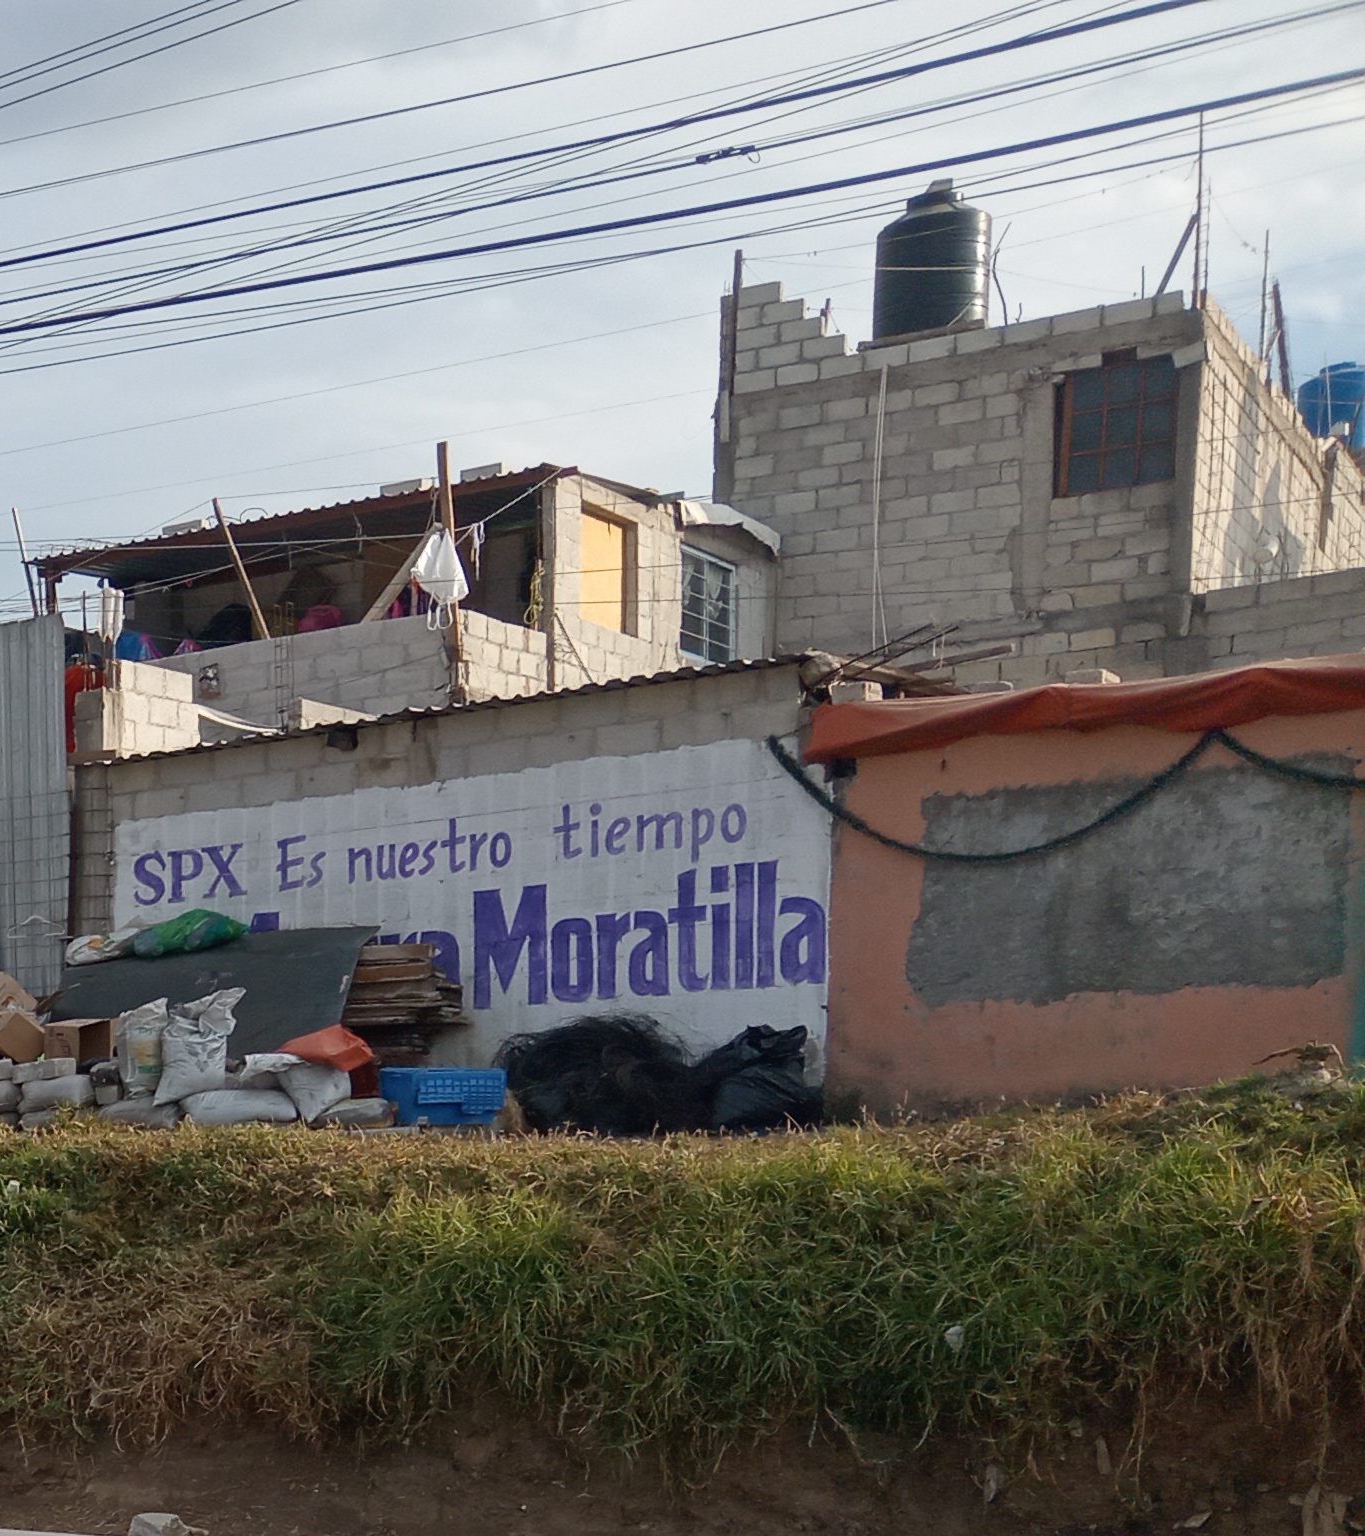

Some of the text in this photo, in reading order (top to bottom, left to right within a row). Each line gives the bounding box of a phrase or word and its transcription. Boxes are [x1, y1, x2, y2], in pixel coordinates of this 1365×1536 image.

[133, 802, 748, 906] SPX Es nuestro tiempo
[472, 858, 827, 1010] Moratilla
